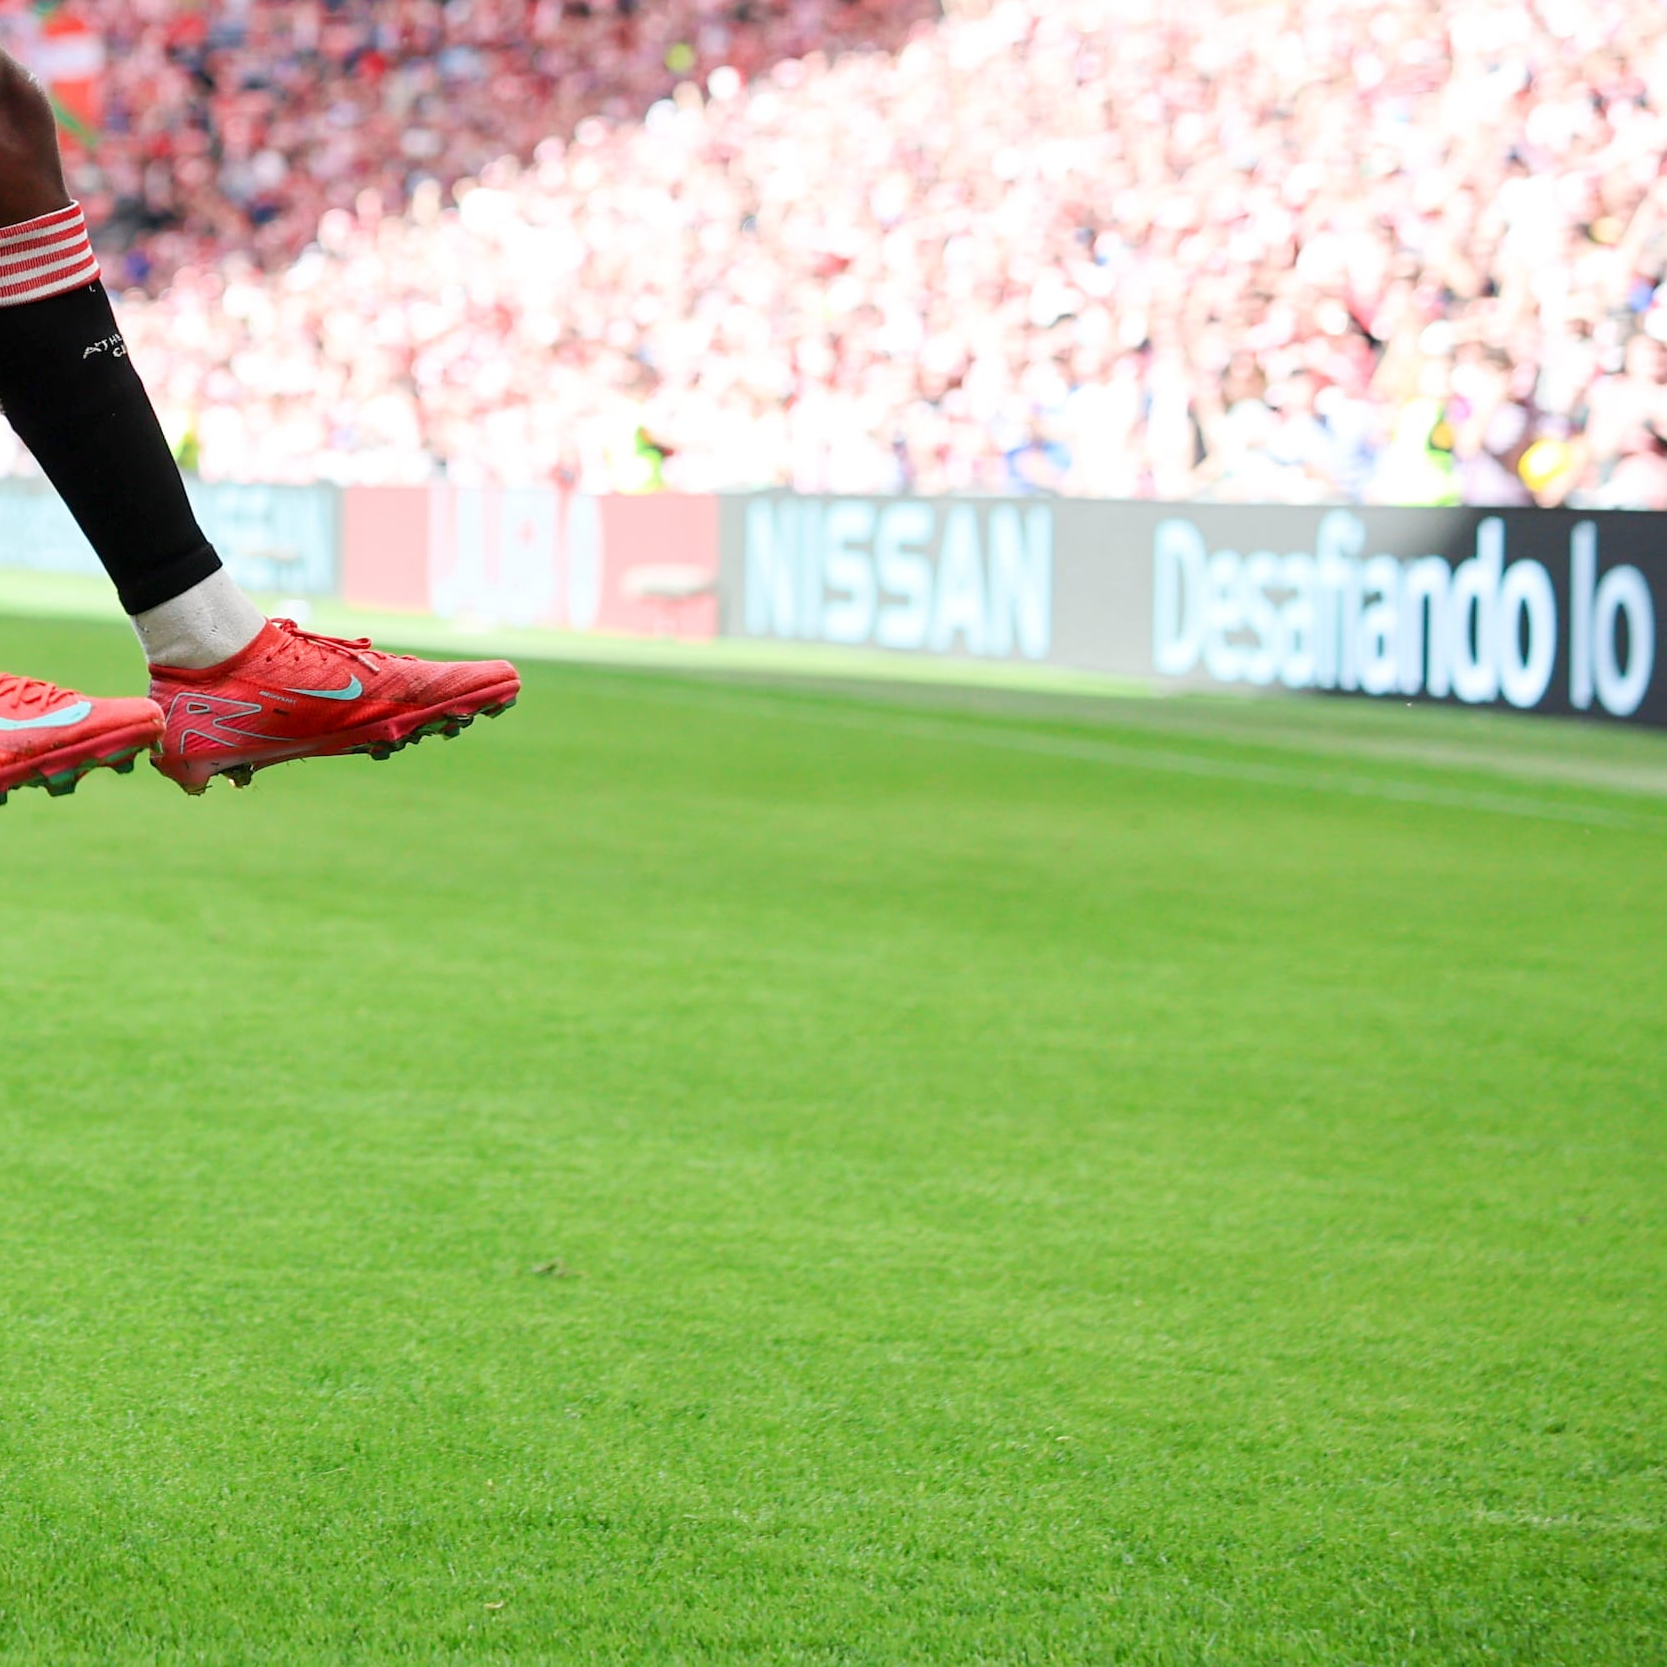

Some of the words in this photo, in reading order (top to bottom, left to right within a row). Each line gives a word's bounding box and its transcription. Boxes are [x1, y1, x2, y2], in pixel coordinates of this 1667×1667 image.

[745, 497, 1055, 660] NISSAN
[1151, 508, 1558, 709] Desafiando
[1568, 518, 1654, 717] lo
